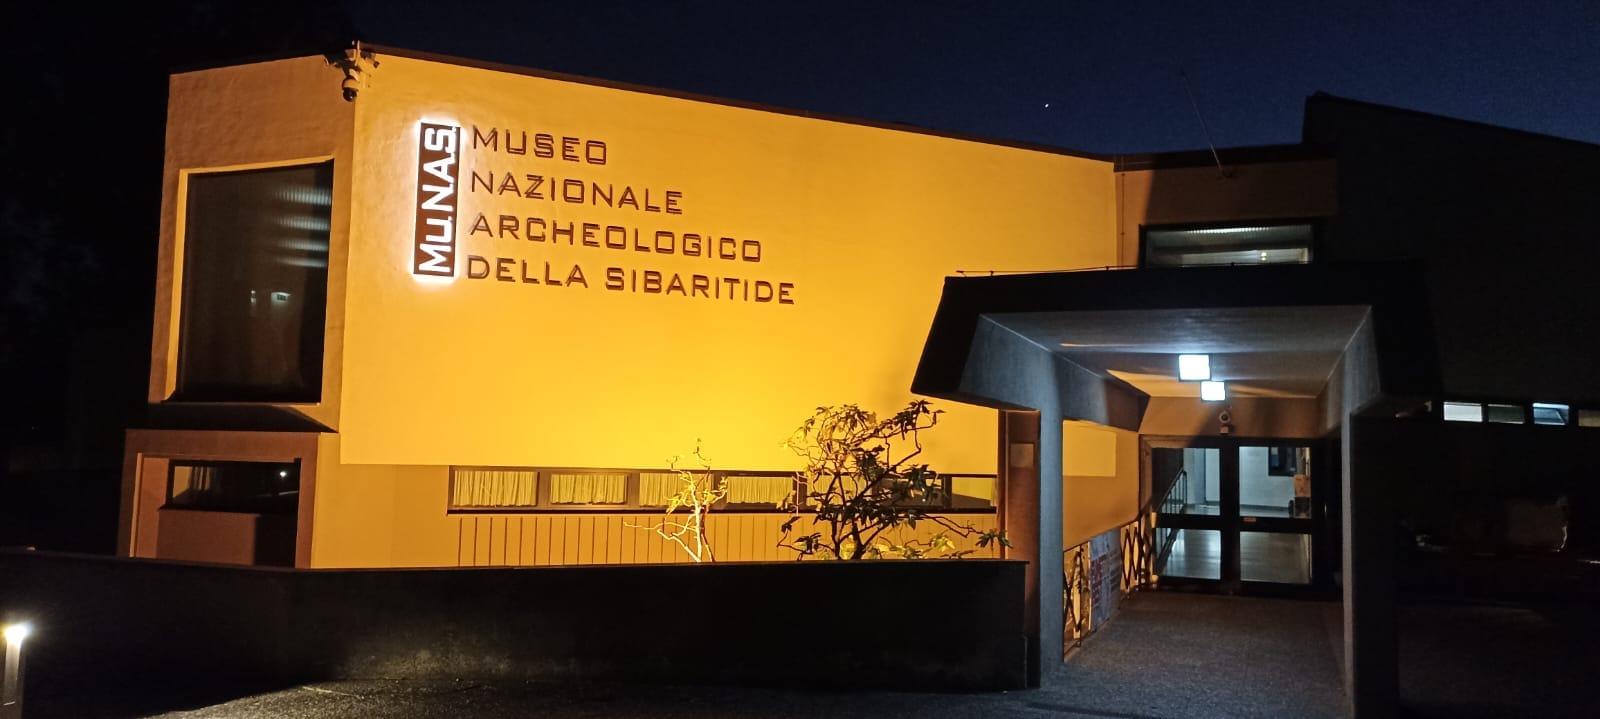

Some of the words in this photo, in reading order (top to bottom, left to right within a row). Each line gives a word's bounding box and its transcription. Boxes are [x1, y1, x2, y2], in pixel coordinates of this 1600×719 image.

[472, 125, 607, 165] MUSEO
[471, 171, 683, 215] NAZIONALE
[470, 212, 761, 262] ARCHEOLOGICO
[467, 255, 588, 288] DELLA
[605, 267, 794, 304] SIBARITIDE
